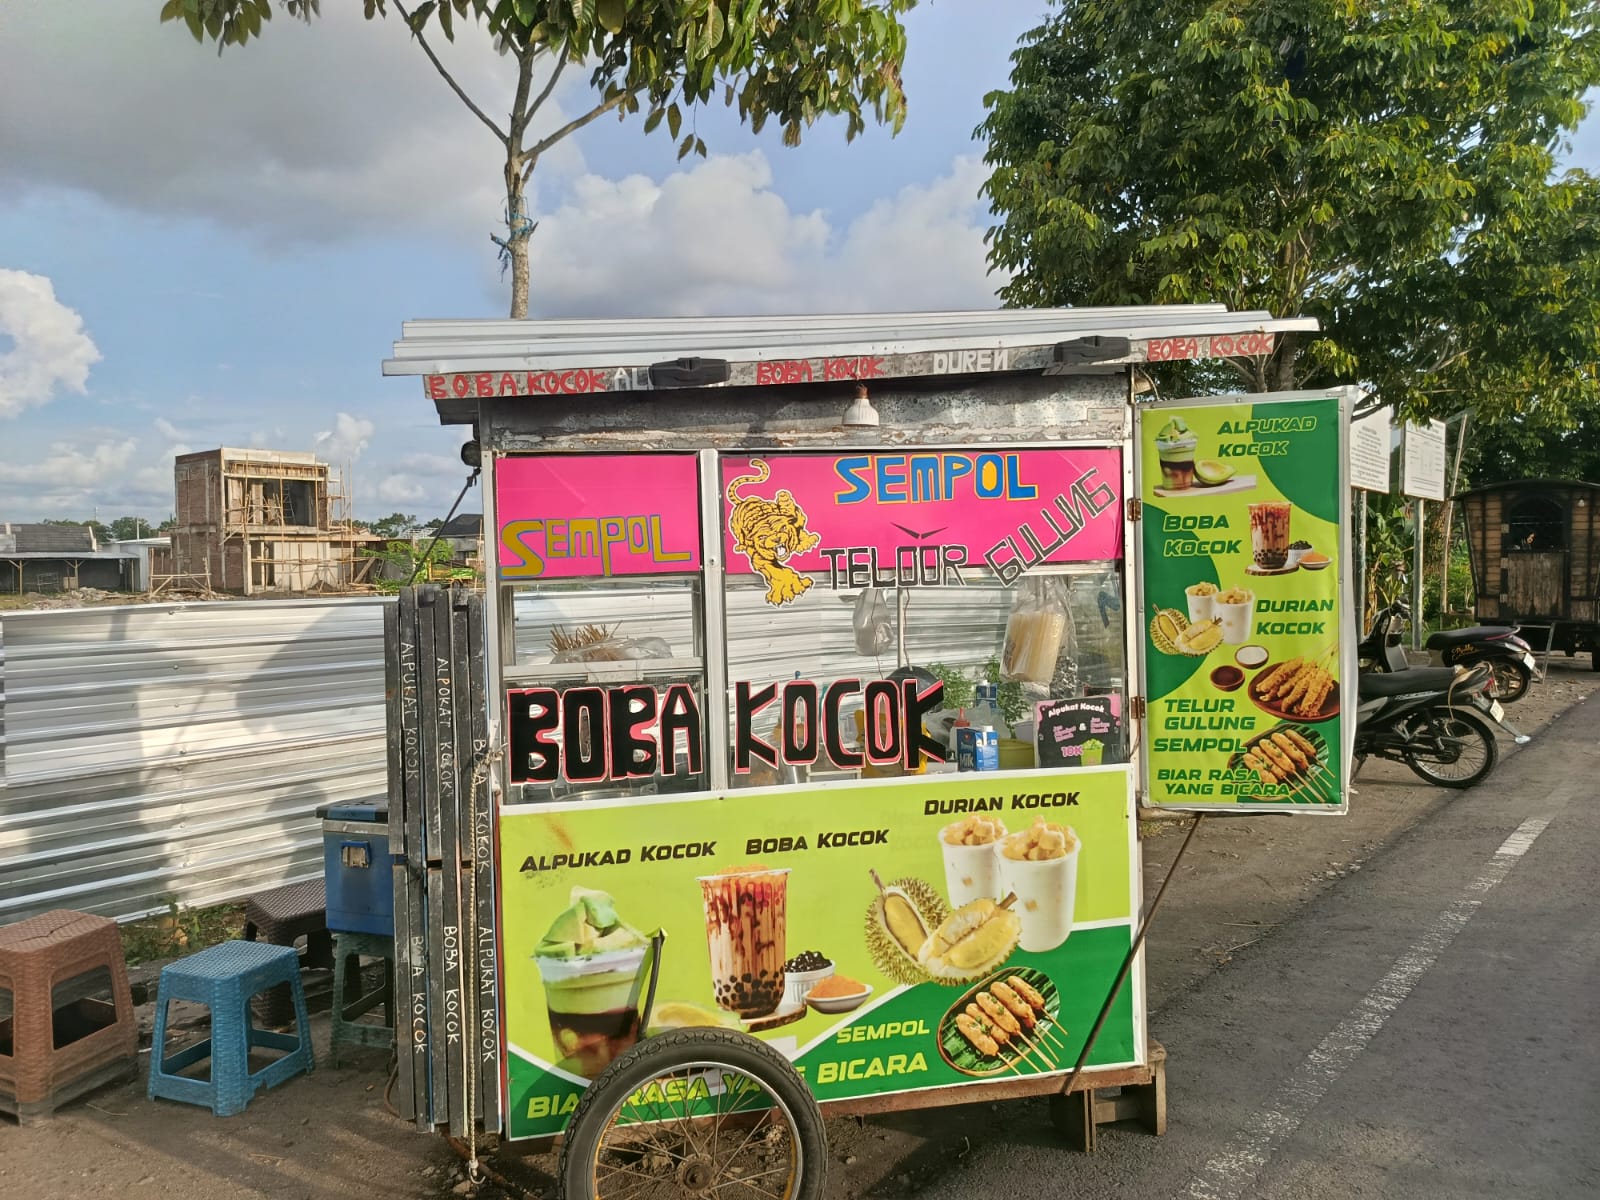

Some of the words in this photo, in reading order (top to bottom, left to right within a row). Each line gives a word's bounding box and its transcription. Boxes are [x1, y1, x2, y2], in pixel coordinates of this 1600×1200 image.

[1147, 337, 1199, 361] BOBA
[1209, 333, 1274, 357] KOCOK
[429, 372, 518, 400] BOBA
[527, 368, 608, 395] KOCOK
[757, 358, 813, 385] BOBA
[824, 356, 885, 382] KOCOK
[1217, 416, 1317, 435] ALPUKAD
[1217, 441, 1290, 458] KOCOK
[834, 453, 1039, 504] SEMPOL
[1163, 515, 1230, 532] BOBA
[500, 514, 692, 579] SEMPOL
[1163, 540, 1243, 558] KOCOK
[1255, 600, 1335, 614] DURIAN
[1256, 621, 1327, 636] KOCOK
[400, 642, 418, 719] ALPUKAT
[436, 657, 452, 728] ALPOKAT
[1164, 699, 1236, 714] TELUR
[506, 683, 704, 786] BOBA
[734, 678, 947, 775] KOCOK
[1164, 716, 1256, 731] GULUNG
[1153, 738, 1249, 753] SEMPOL
[1157, 769, 1202, 781] BIAR
[1208, 769, 1261, 781] RASA
[924, 797, 1003, 815] DURIAN
[1011, 792, 1080, 810] KOCOK
[1166, 784, 1214, 795] YANG
[1220, 784, 1291, 796] BICARA
[746, 836, 808, 855] BOBA
[817, 829, 890, 849] KOCOK
[519, 849, 632, 873] ALPUKAD
[640, 841, 718, 862] KOCOK
[444, 926, 458, 972] BOBA
[479, 927, 496, 997] ALPUKAT
[412, 992, 427, 1054] KOCOK
[446, 988, 460, 1045] KOCOK
[482, 1008, 496, 1062] KOCOK
[836, 1019, 931, 1044] SEMPOL
[526, 1092, 581, 1119] BIA
[817, 1052, 929, 1084] BICARA
